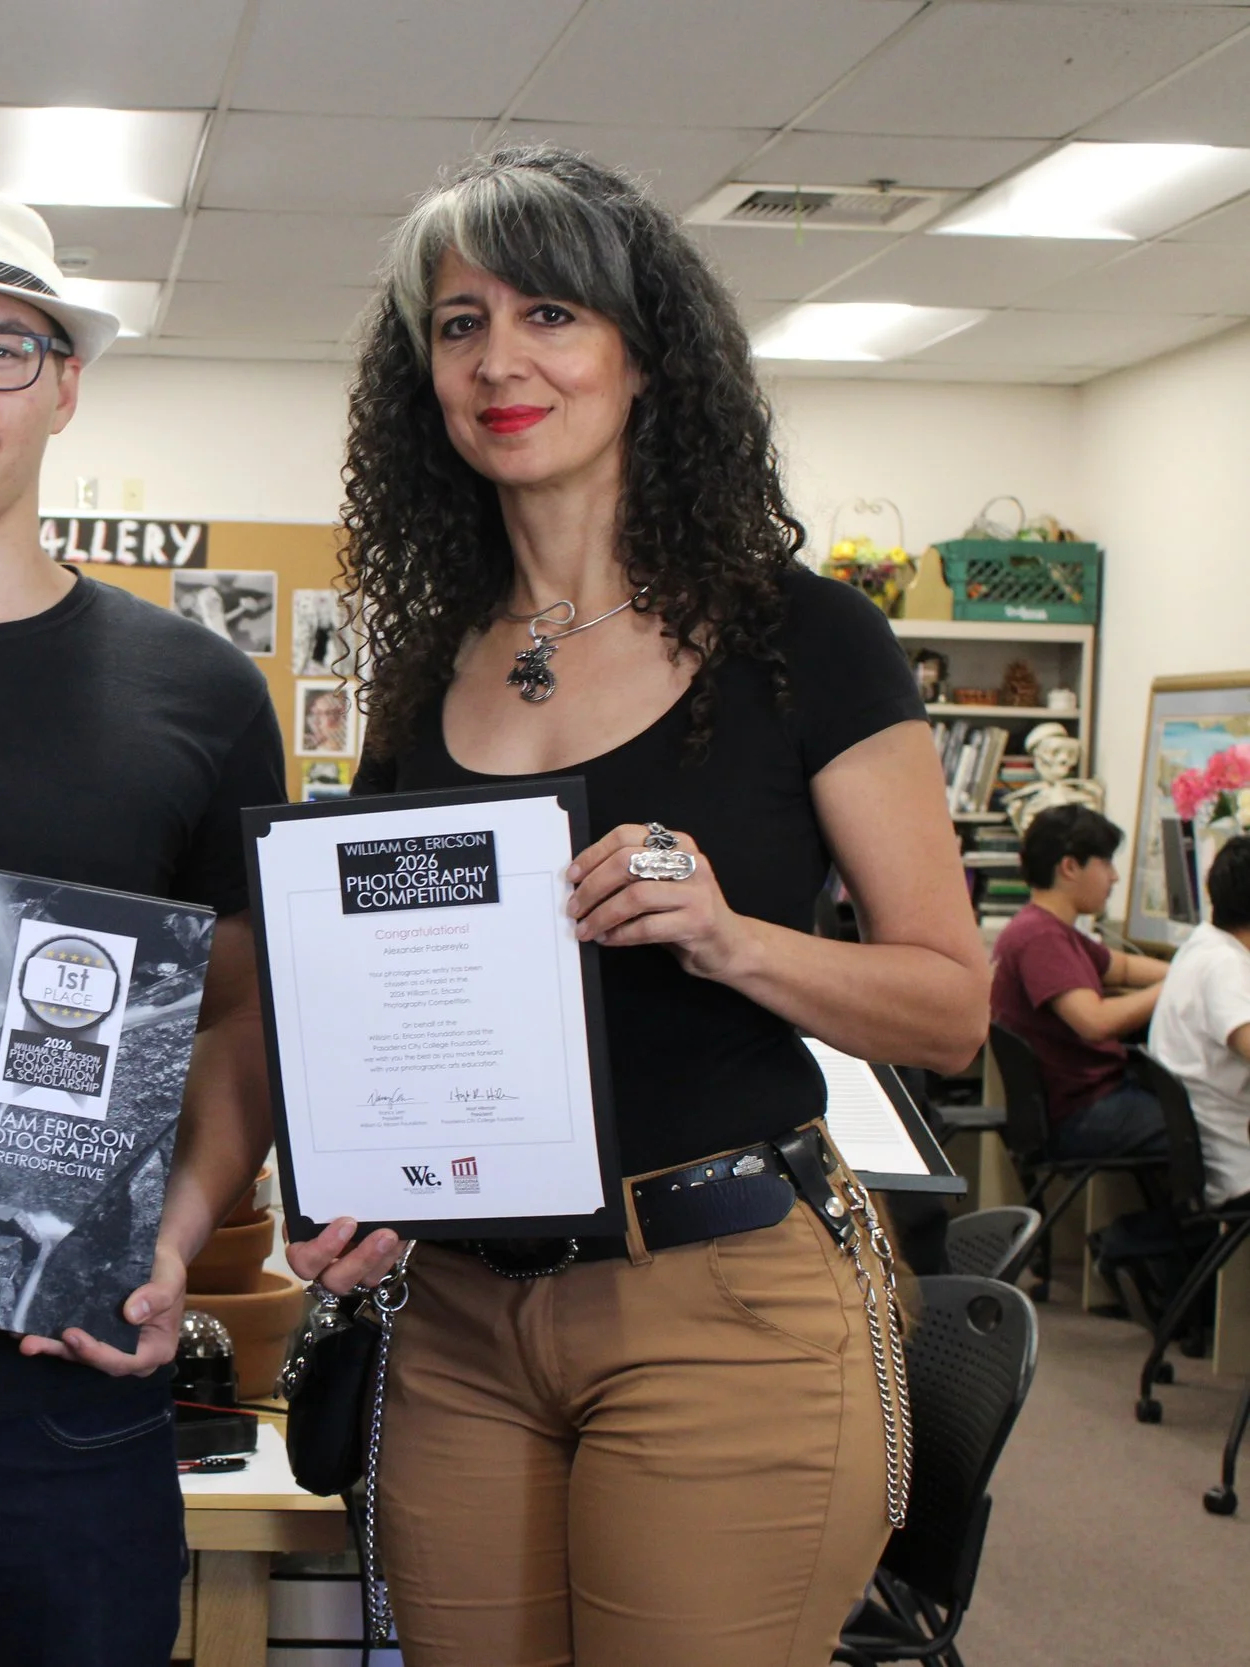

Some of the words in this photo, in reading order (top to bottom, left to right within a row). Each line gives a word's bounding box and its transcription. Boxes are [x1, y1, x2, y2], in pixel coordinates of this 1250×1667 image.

[40, 519, 201, 566] ALLERY
[345, 841, 401, 856] WILLIAM
[405, 839, 422, 852] G.
[425, 833, 487, 850] ERICSON
[395, 854, 439, 872] 2026
[346, 865, 490, 892] PHOTOGRAPHY
[356, 883, 484, 909] COMPETITION
[374, 923, 470, 940] Congratulations!
[383, 946, 424, 956] Alexander
[56, 964, 90, 992] 1st
[43, 987, 94, 1007] PLACE
[14, 1042, 49, 1055] WILLIAM
[63, 1051, 101, 1064] ERICSON
[43, 1037, 73, 1051] 2026
[9, 1049, 103, 1074] PHOTOGRAPHY
[13, 1060, 95, 1082] COMPETITION
[5, 1069, 14, 1080] &
[17, 1070, 100, 1093] SCHOLARSHIP
[43, 1118, 136, 1151] ERICSON
